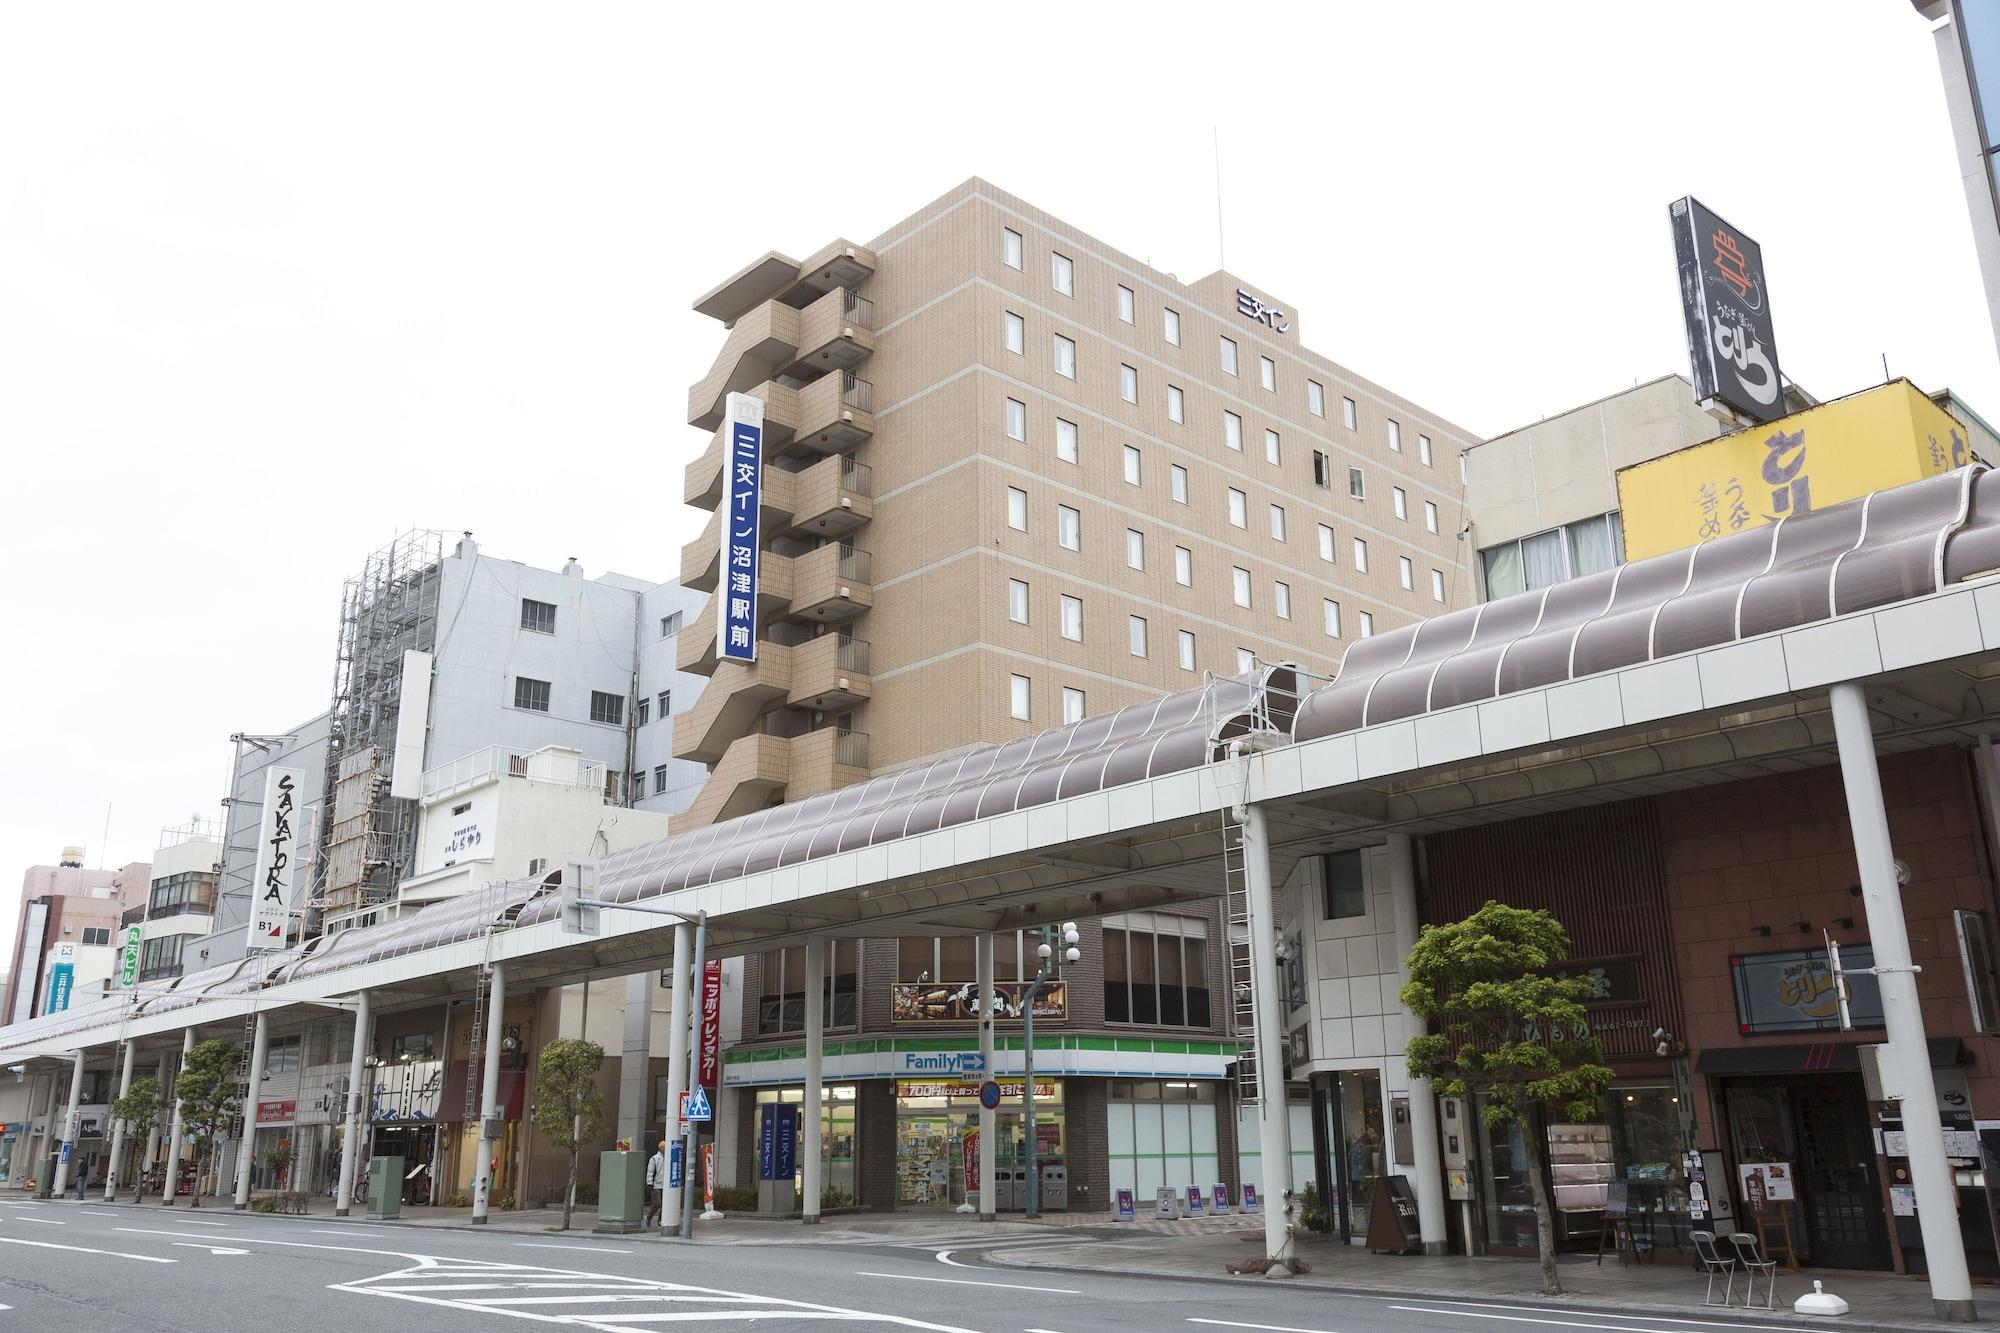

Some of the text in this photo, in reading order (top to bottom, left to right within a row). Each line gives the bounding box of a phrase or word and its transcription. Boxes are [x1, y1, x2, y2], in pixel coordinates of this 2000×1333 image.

[1236, 288, 1290, 333] 三交イン
[1717, 301, 1738, 321] うなぎ
[731, 434, 756, 649] 三交イン沼津駅前
[264, 775, 295, 906] SAVATORA
[259, 921, 272, 931] B1
[123, 928, 139, 985] 丸天ビル
[54, 972, 69, 1013] 三井住友信
[703, 976, 719, 1079] ニッポンレンタカー
[906, 1053, 963, 1073] Family
[764, 1129, 773, 1177] 三交イン
[780, 1129, 791, 1177] 三交イン
